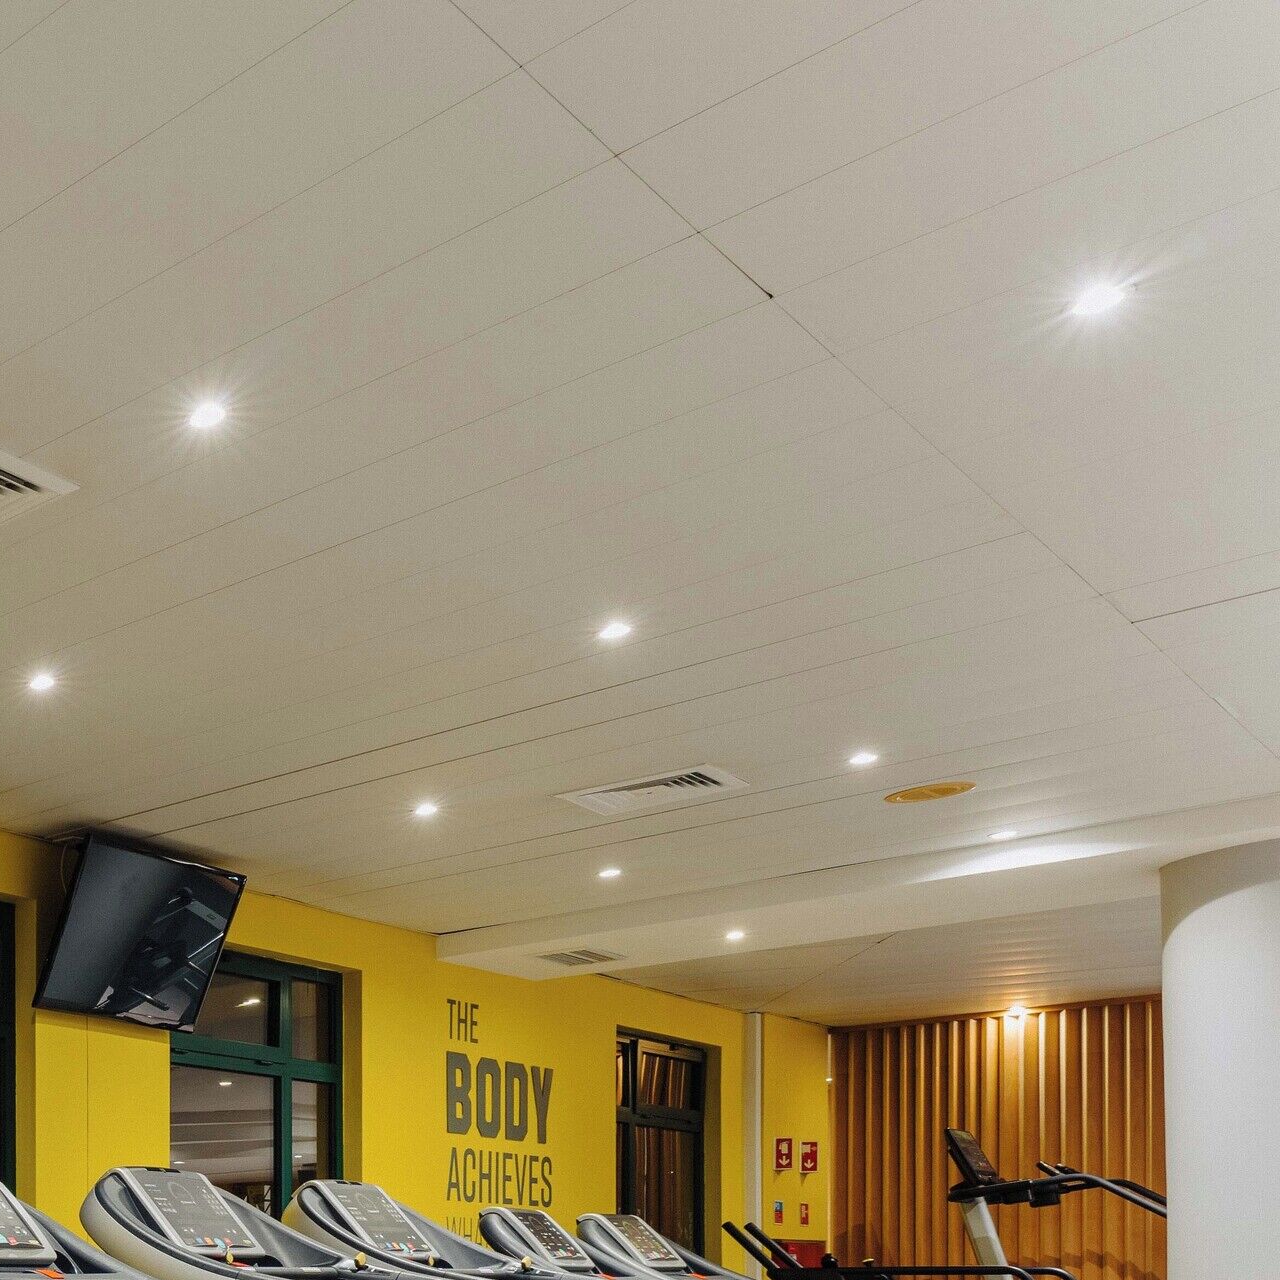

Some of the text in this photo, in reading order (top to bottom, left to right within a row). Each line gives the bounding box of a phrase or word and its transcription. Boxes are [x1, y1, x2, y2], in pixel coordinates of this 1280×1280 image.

[447, 999, 479, 1043] THE
[446, 1050, 554, 1144] BODY
[446, 1146, 553, 1208] ACHIEVES
